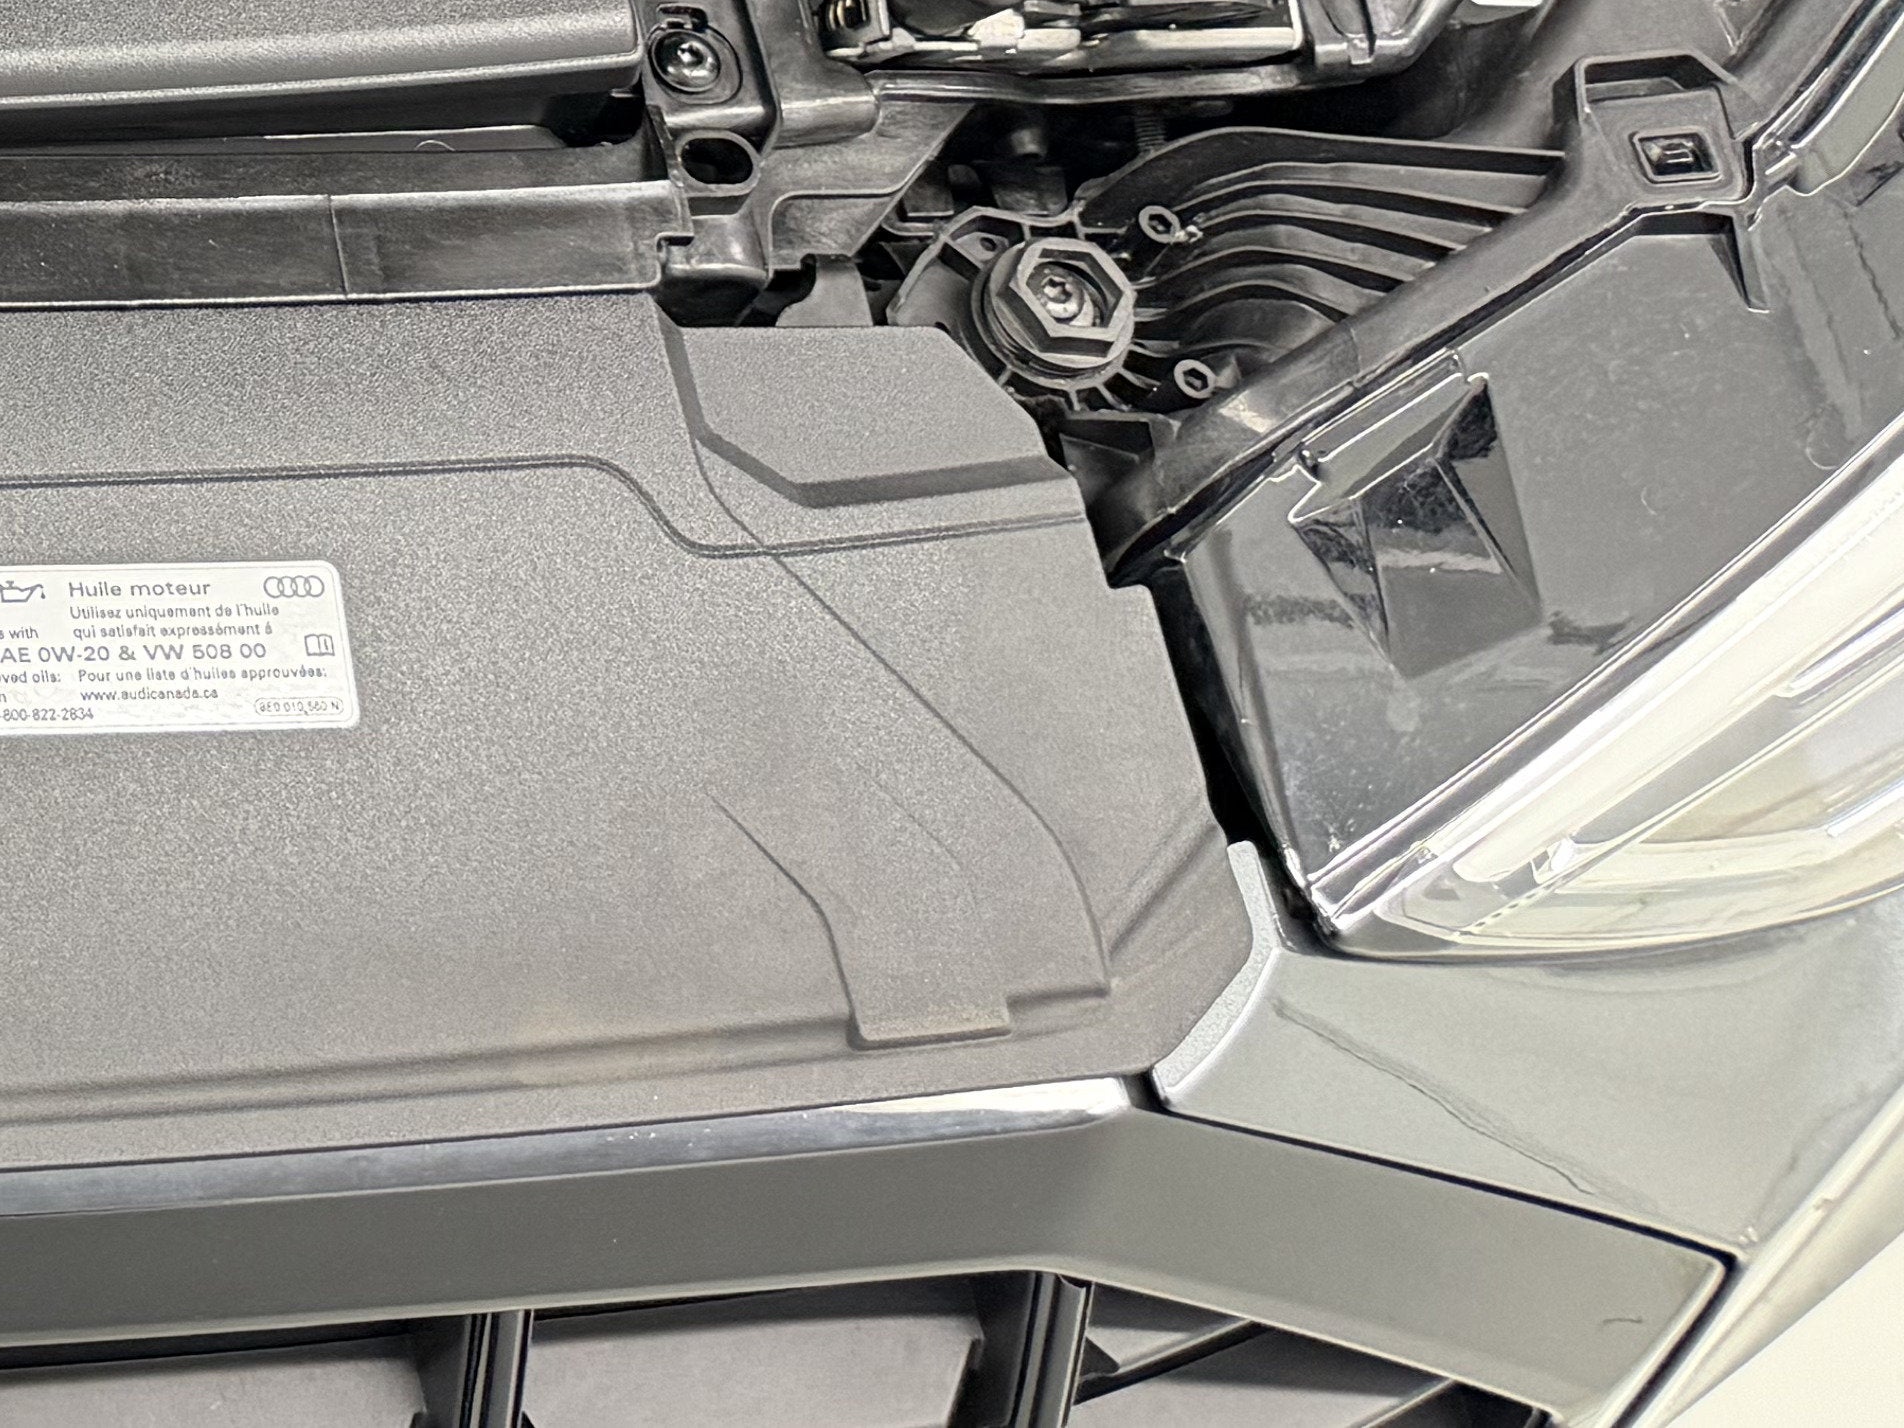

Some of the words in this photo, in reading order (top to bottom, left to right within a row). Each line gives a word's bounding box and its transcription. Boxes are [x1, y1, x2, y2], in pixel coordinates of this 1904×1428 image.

[68, 582, 122, 598] Huile
[130, 581, 211, 596] moteur
[70, 605, 121, 619] Utilisez
[126, 605, 211, 621] uniquement
[215, 605, 232, 618] de
[236, 603, 279, 617] l'huile
[9, 627, 39, 639] with
[73, 626, 96, 641] qui
[100, 625, 156, 638] satisfait
[160, 623, 260, 640] expressément
[38, 645, 109, 663] 0W-20
[118, 646, 136, 661] &
[143, 644, 184, 661] VW
[193, 643, 232, 660] 508
[239, 642, 267, 659] 00
[32, 669, 61, 683] oils:
[78, 669, 111, 682] Pour
[118, 669, 142, 682] une
[146, 668, 176, 681] liste
[180, 666, 236, 681] d'huiles
[241, 664, 327, 681] approuvées:
[80, 687, 218, 701] www.audicanada.ca
